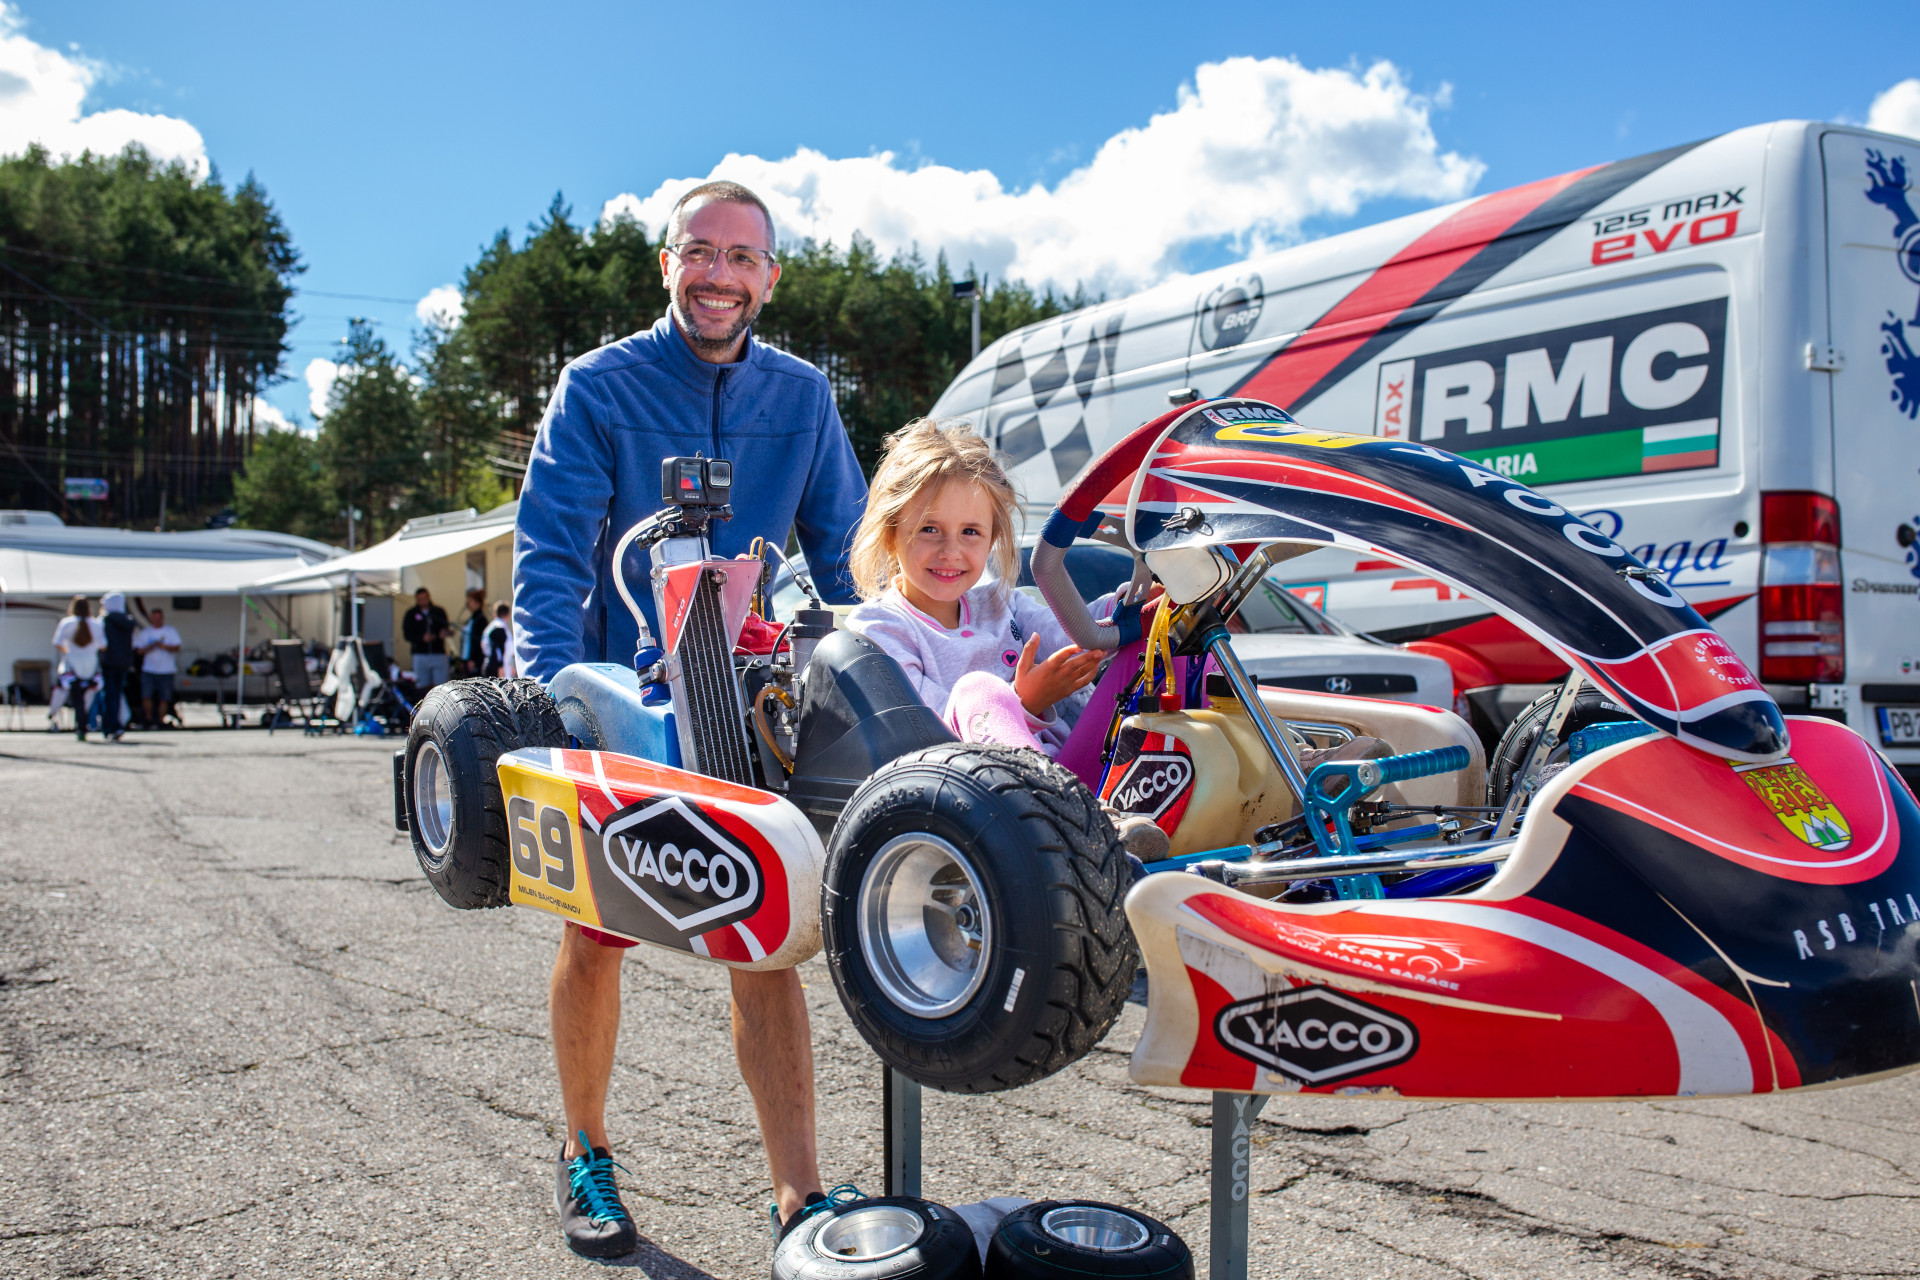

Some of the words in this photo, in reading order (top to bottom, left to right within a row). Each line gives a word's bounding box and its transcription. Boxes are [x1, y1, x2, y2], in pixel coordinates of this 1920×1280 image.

[1593, 209, 1652, 236] 125
[1384, 380, 1405, 438] TAX
[1420, 322, 1710, 441] RMC
[1217, 407, 1287, 421] RMC
[1389, 447, 1686, 608] YACCO
[1118, 763, 1182, 810] YACCO
[508, 796, 576, 893] 69
[619, 835, 738, 899] YACCO
[1276, 933, 1321, 953] YOUR
[1324, 950, 1385, 972] MAZDA
[1389, 968, 1460, 991] GARAGE
[1338, 943, 1405, 962] KRT
[1793, 912, 1857, 960] RSB
[1244, 1016, 1391, 1054] YACCO
[1231, 1095, 1250, 1201] YACCO
